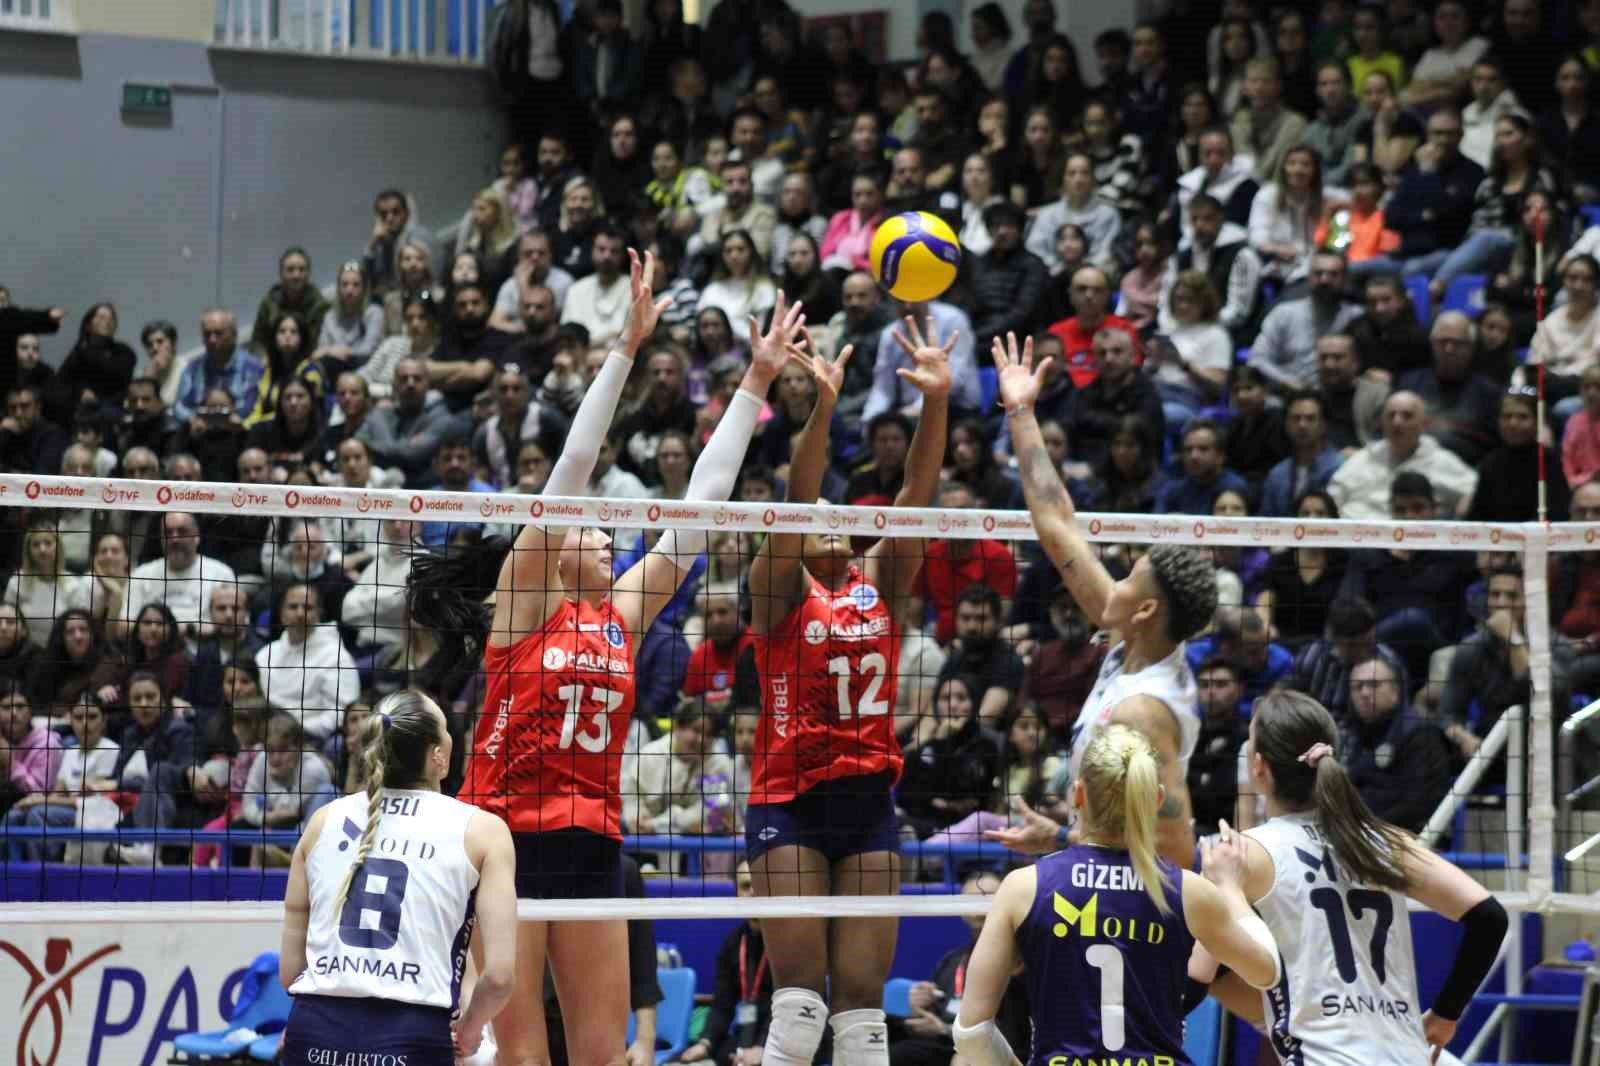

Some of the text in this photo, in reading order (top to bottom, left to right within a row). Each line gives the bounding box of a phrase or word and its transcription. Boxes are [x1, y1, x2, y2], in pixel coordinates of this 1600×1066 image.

[42, 486, 85, 497] vodafone
[119, 490, 140, 499] TVF
[174, 491, 215, 501] vodafone
[248, 495, 268, 504] TVF
[302, 495, 341, 506] vodafone
[373, 500, 393, 509] TVF
[425, 500, 464, 511] vodafone
[495, 504, 515, 514] TVF
[545, 504, 584, 515] vodafone
[613, 509, 633, 519] TVF
[662, 508, 699, 519] vodafone
[729, 512, 748, 522] TVF
[777, 511, 813, 522] vodafone
[558, 684, 625, 753] 13
[828, 652, 889, 720] 12
[339, 857, 409, 950] 8
[1071, 858, 1144, 891] GİZEM
[1053, 890, 1165, 944] MOLD
[1309, 887, 1394, 986] 17
[314, 955, 421, 985] SANMAR
[1085, 944, 1126, 1051] 1
